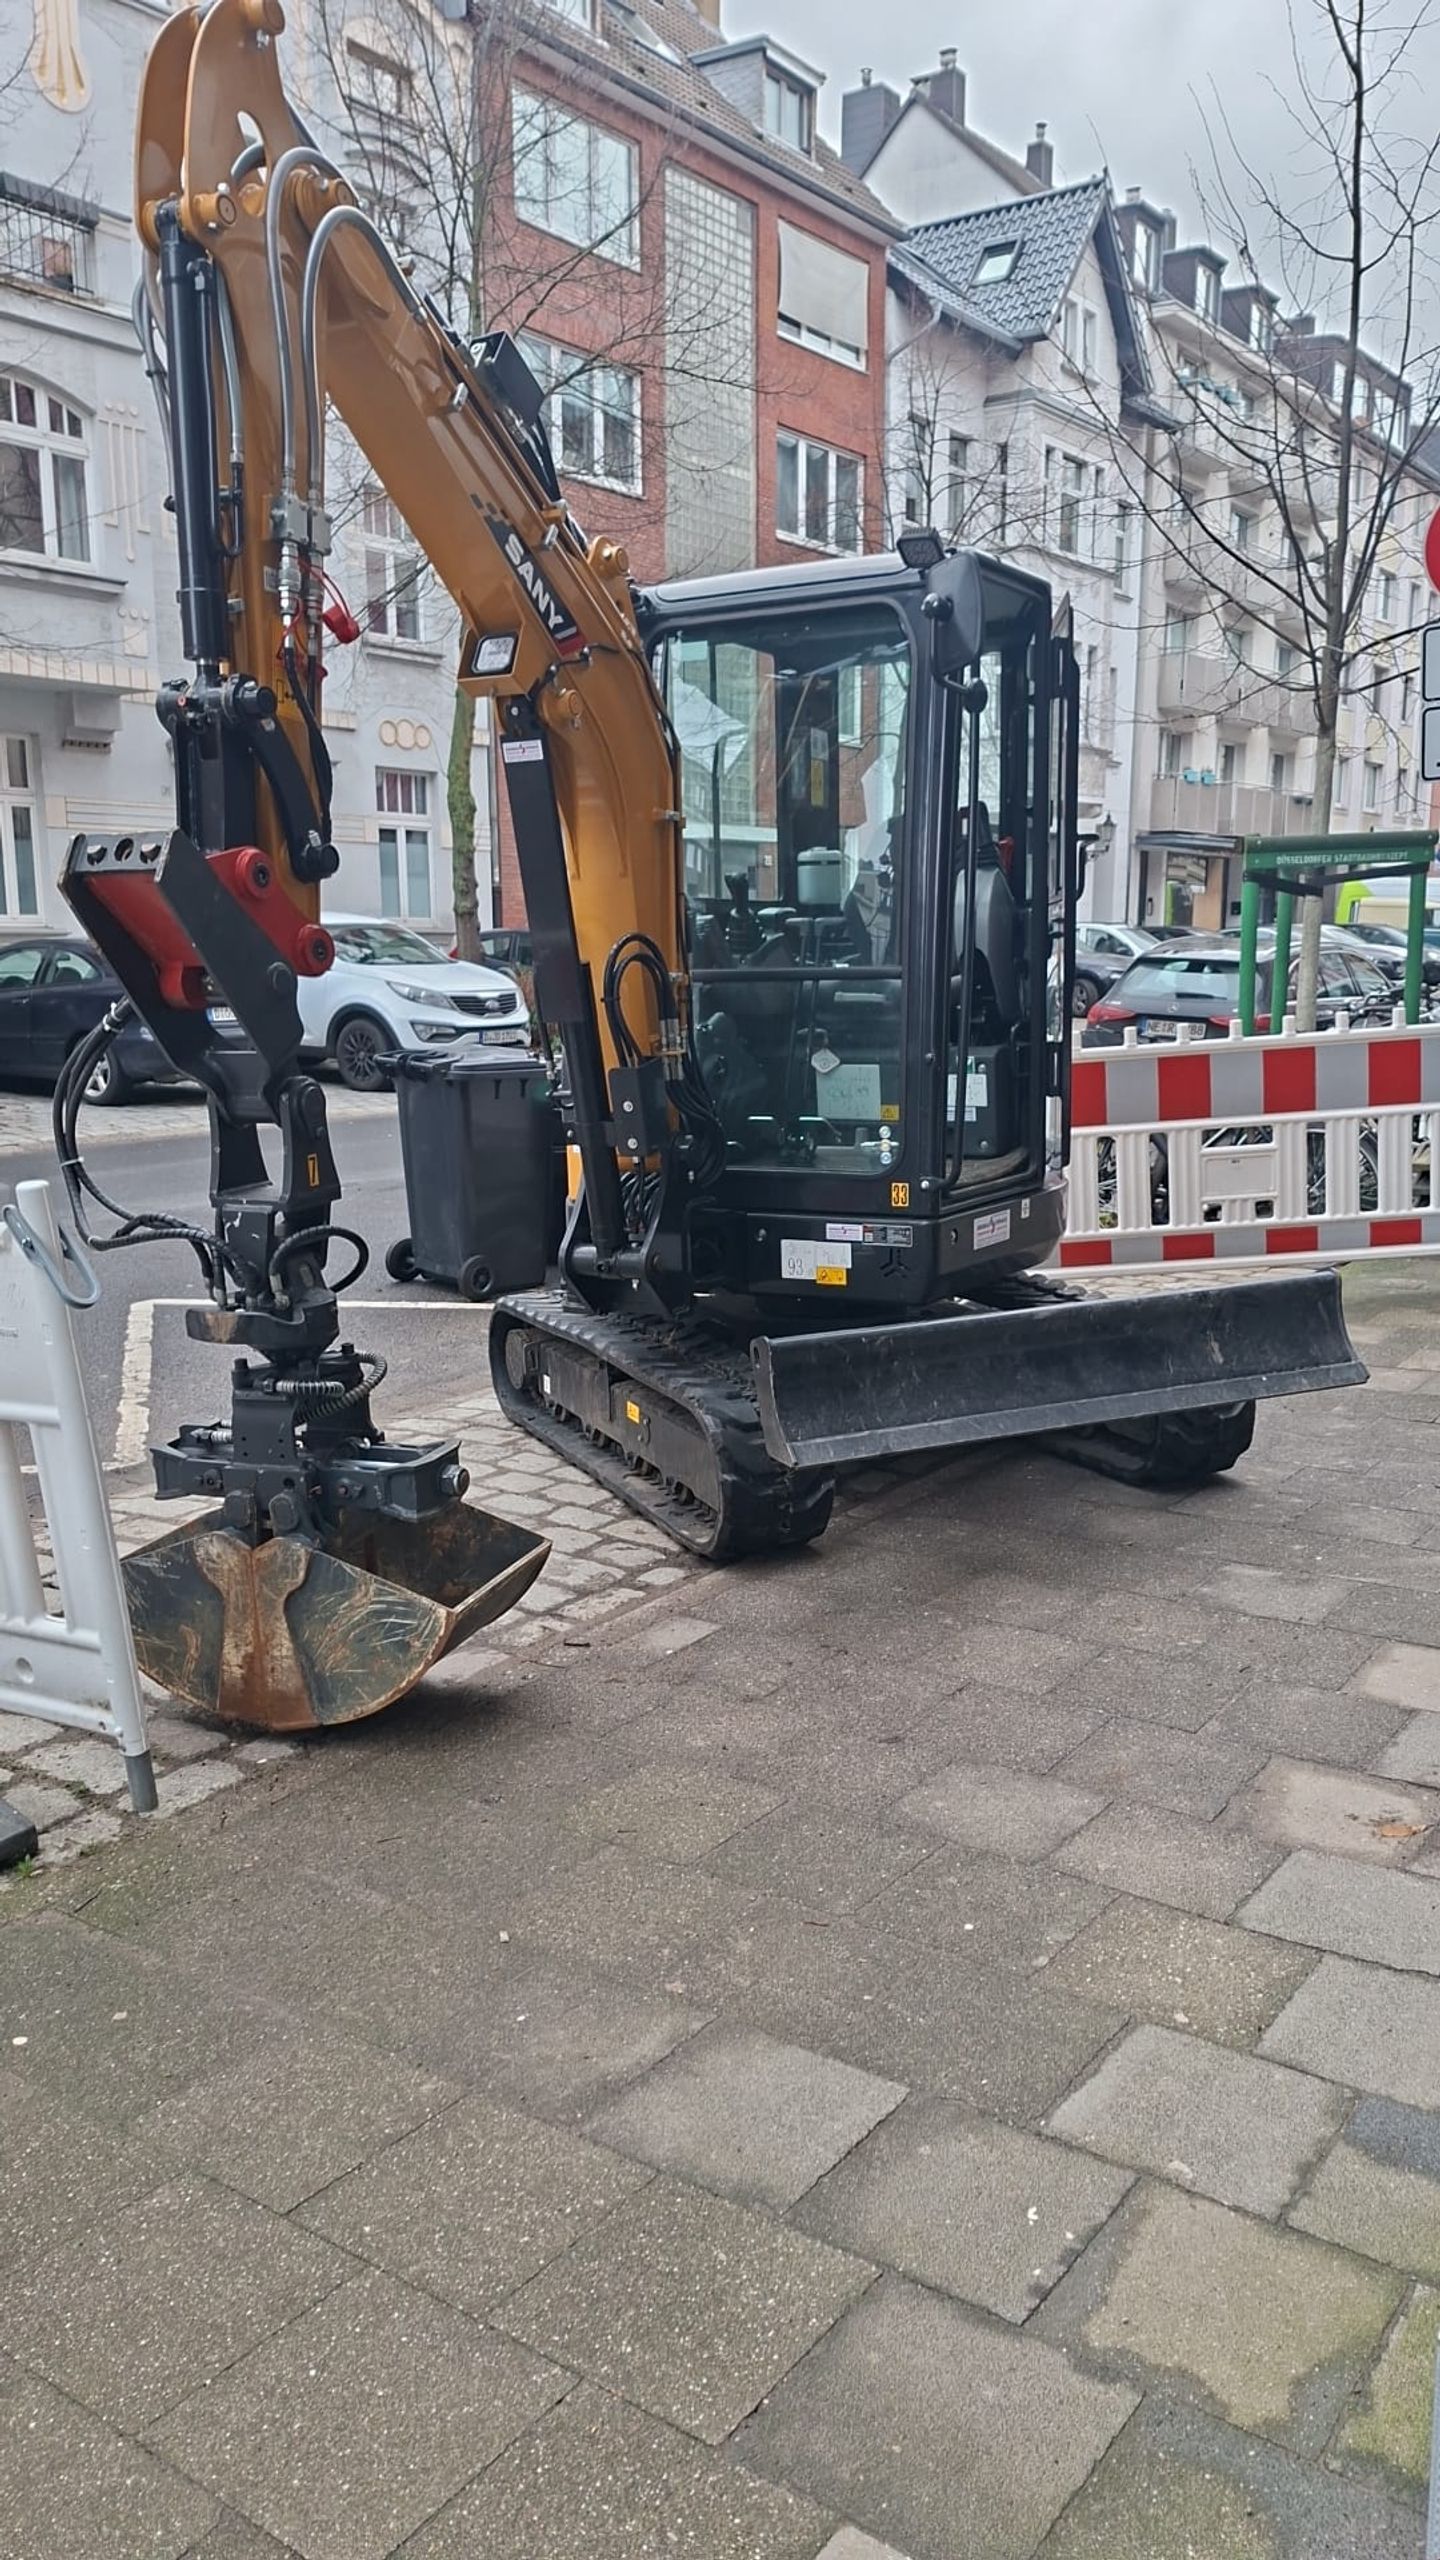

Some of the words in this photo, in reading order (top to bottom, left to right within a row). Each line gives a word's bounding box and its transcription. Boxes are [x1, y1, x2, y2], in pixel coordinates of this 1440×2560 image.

[504, 533, 565, 634] SANY
[893, 1184, 908, 1205] 33
[788, 1257, 804, 1276] 93
